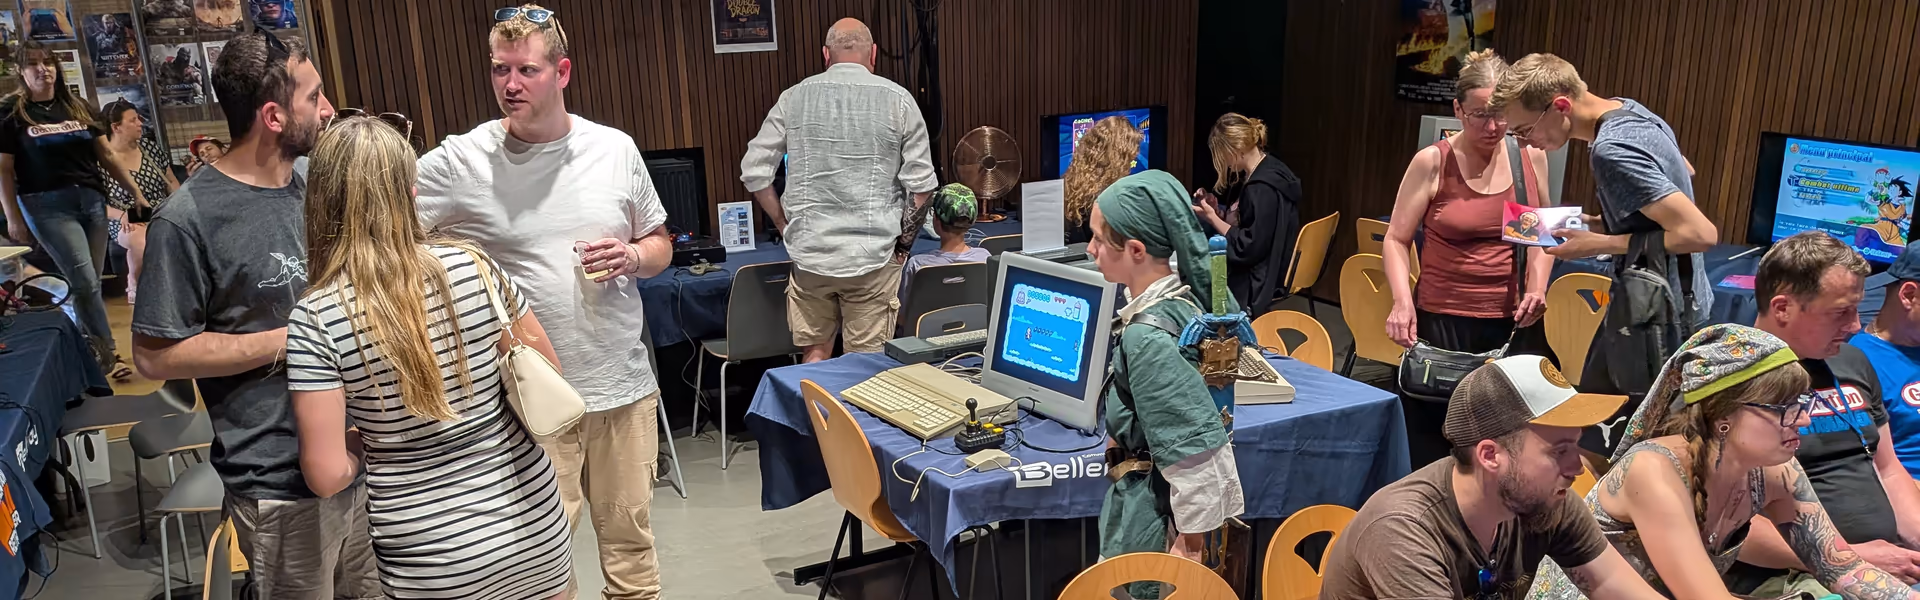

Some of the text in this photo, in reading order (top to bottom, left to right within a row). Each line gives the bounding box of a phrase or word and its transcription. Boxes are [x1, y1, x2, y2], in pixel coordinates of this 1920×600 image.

[730, 5, 760, 17] DRAGON
[1799, 144, 1874, 163] Menu principal
